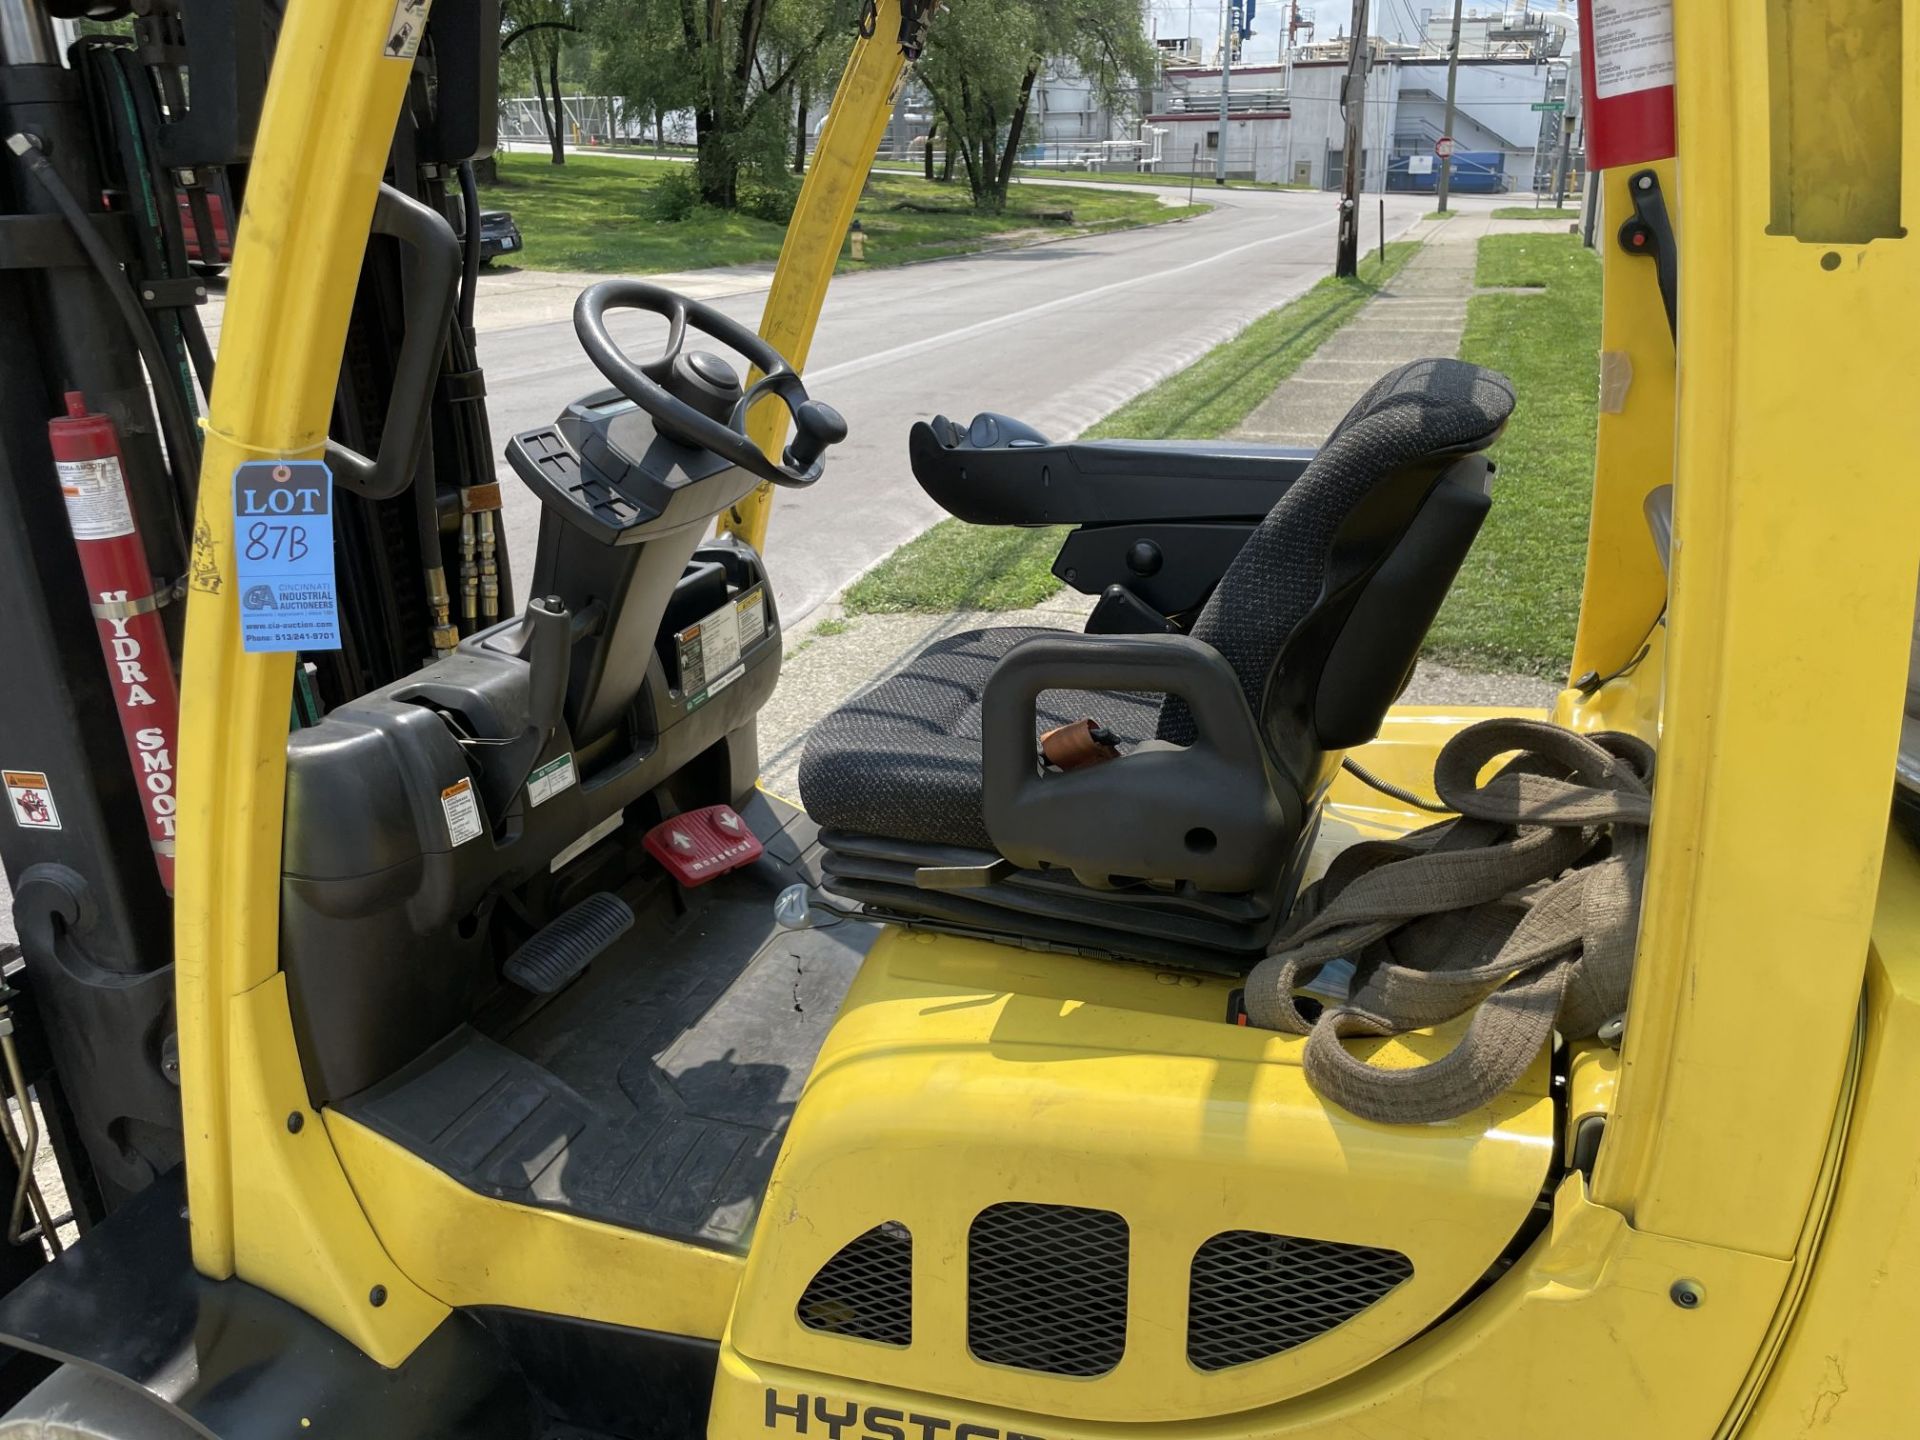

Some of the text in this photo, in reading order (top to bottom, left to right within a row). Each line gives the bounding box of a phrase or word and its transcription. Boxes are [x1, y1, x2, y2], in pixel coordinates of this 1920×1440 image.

[244, 488, 321, 514] LOT
[245, 521, 309, 562] 87B
[278, 583, 331, 592] CINCINNATI
[279, 591, 333, 601] INDUSTRIAL
[280, 601, 334, 610] AUCTIONEERS
[136, 727, 176, 858] SMOOT
[765, 1387, 1047, 1440] HYST
